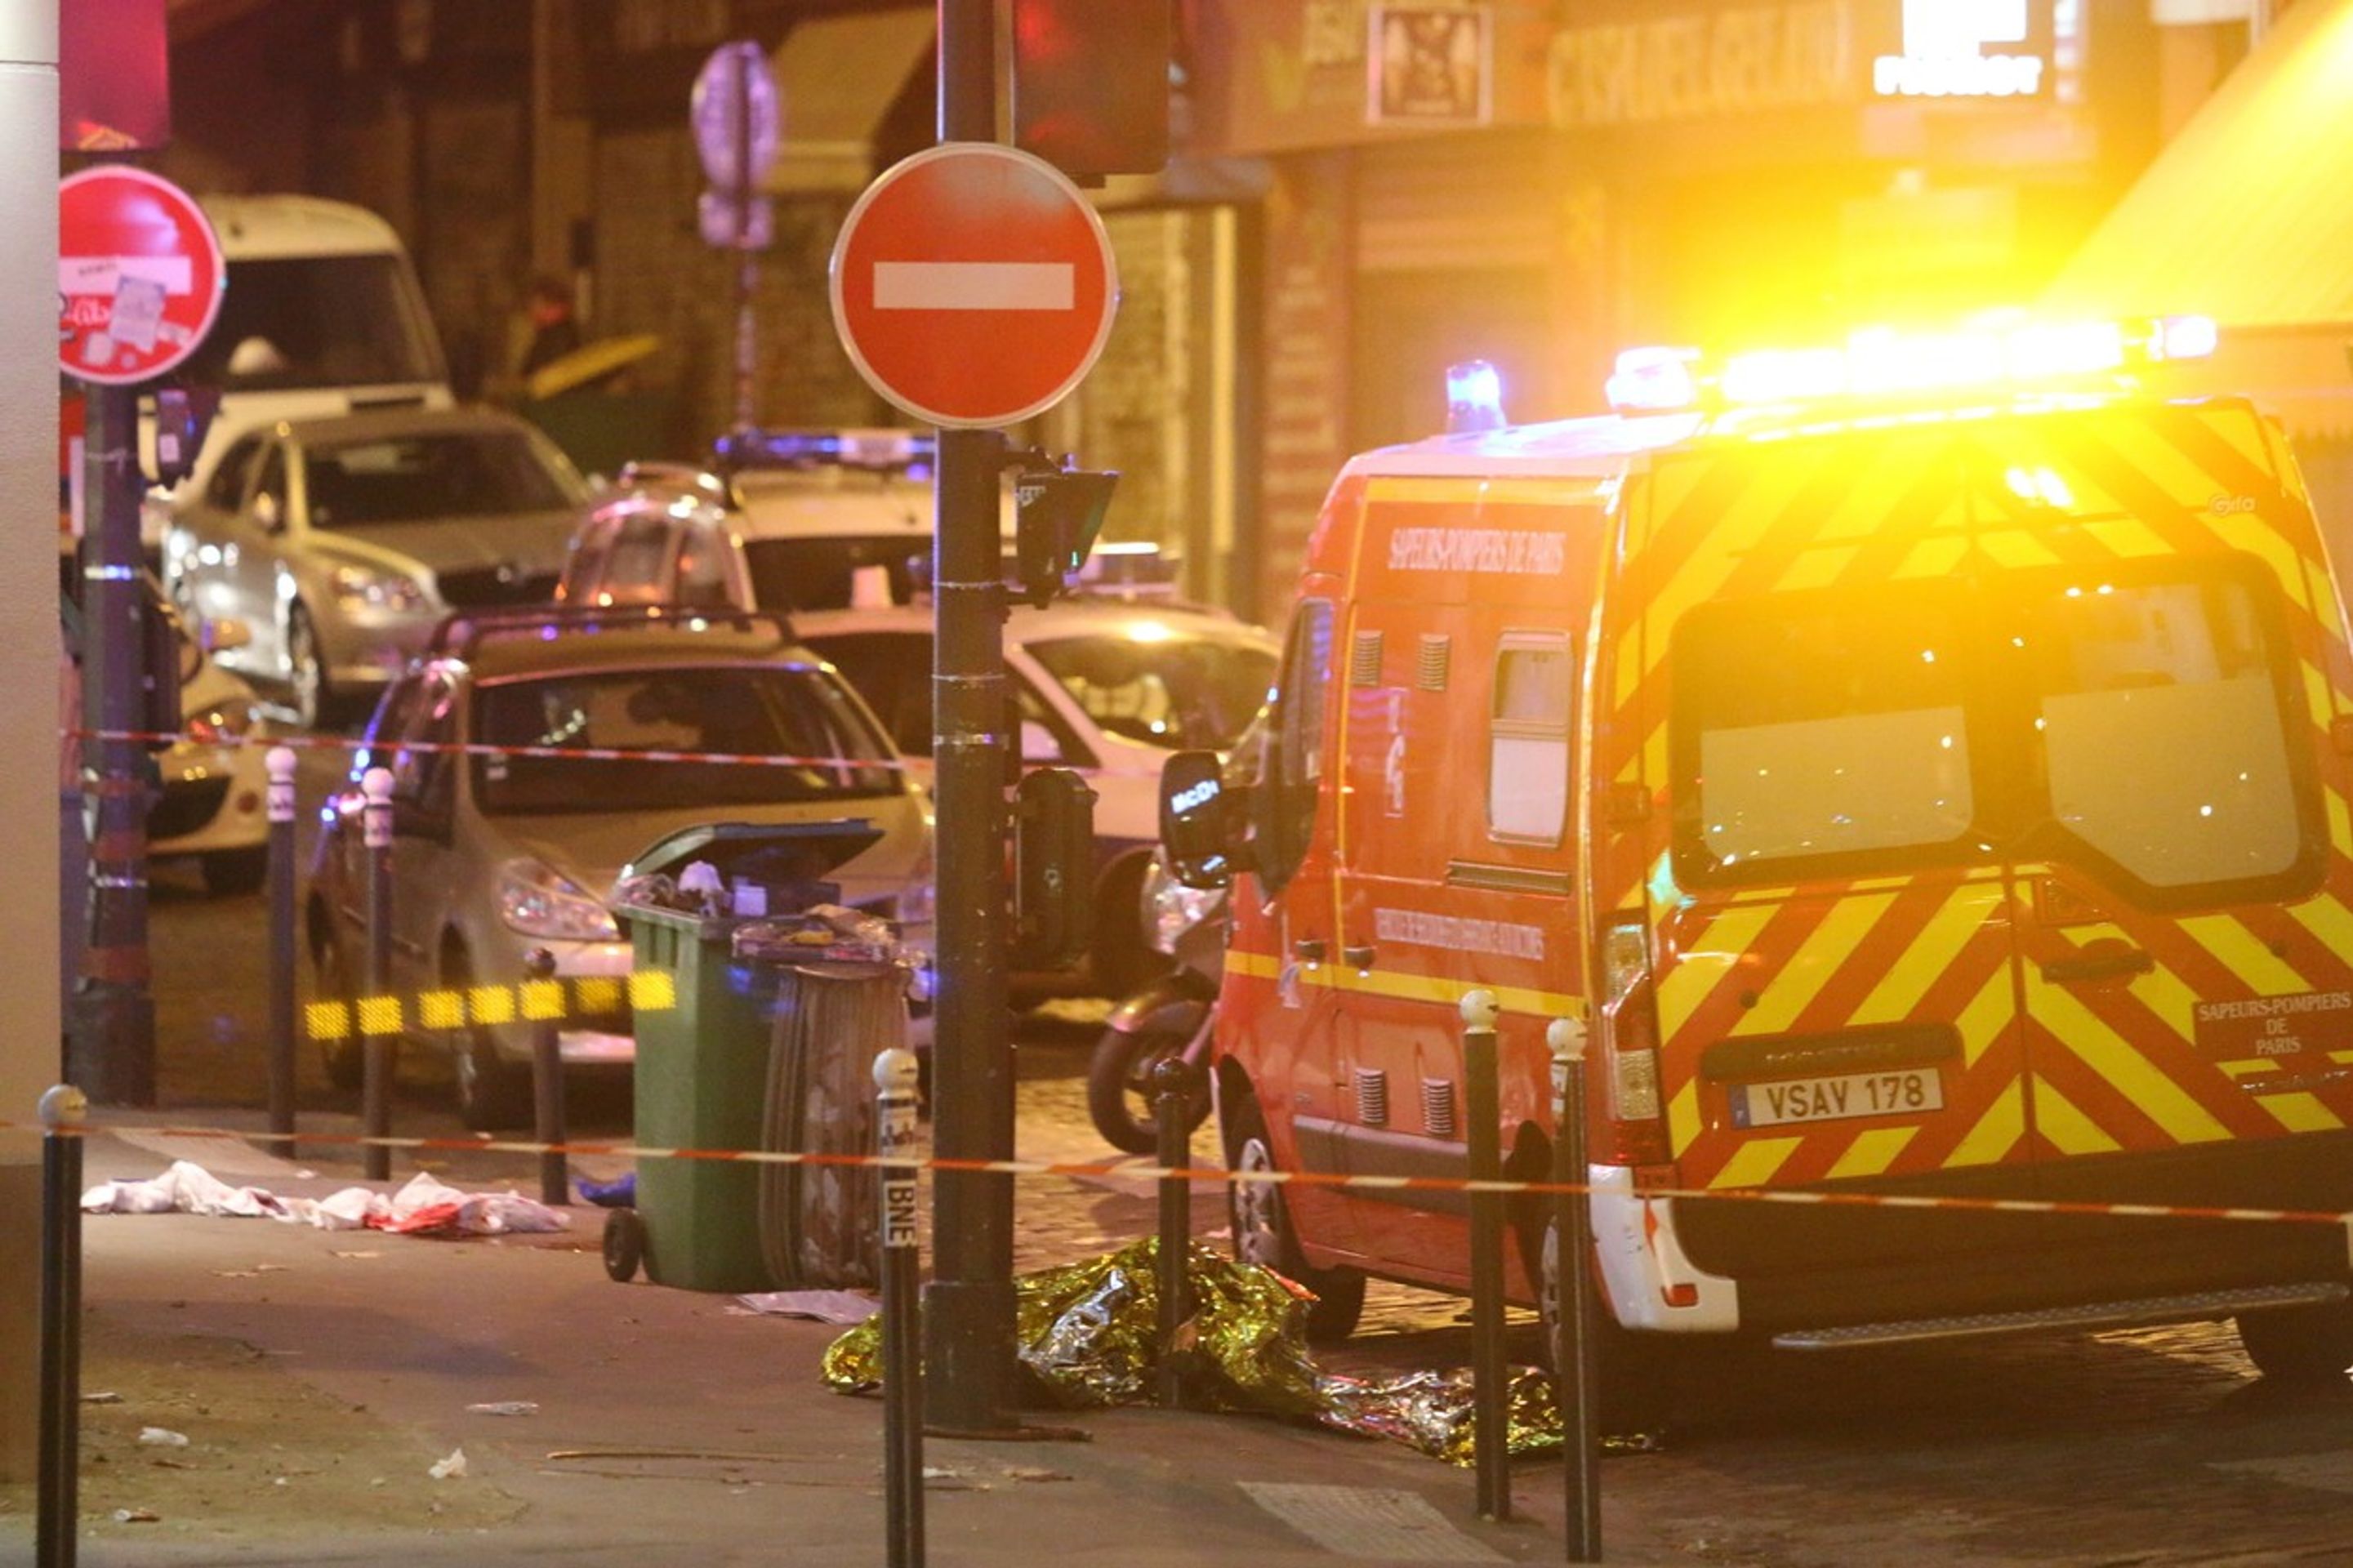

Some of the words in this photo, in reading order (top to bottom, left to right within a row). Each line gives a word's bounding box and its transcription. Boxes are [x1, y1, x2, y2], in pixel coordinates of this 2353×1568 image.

[2198, 991, 2352, 1021] SAPEURS-POMPIERS
[2266, 1018, 2288, 1035] DE
[2256, 1036, 2302, 1055] PARIS
[1767, 1080, 1848, 1119] VSAV
[1865, 1074, 1925, 1110] 178
[887, 1187, 916, 1243] BNE
